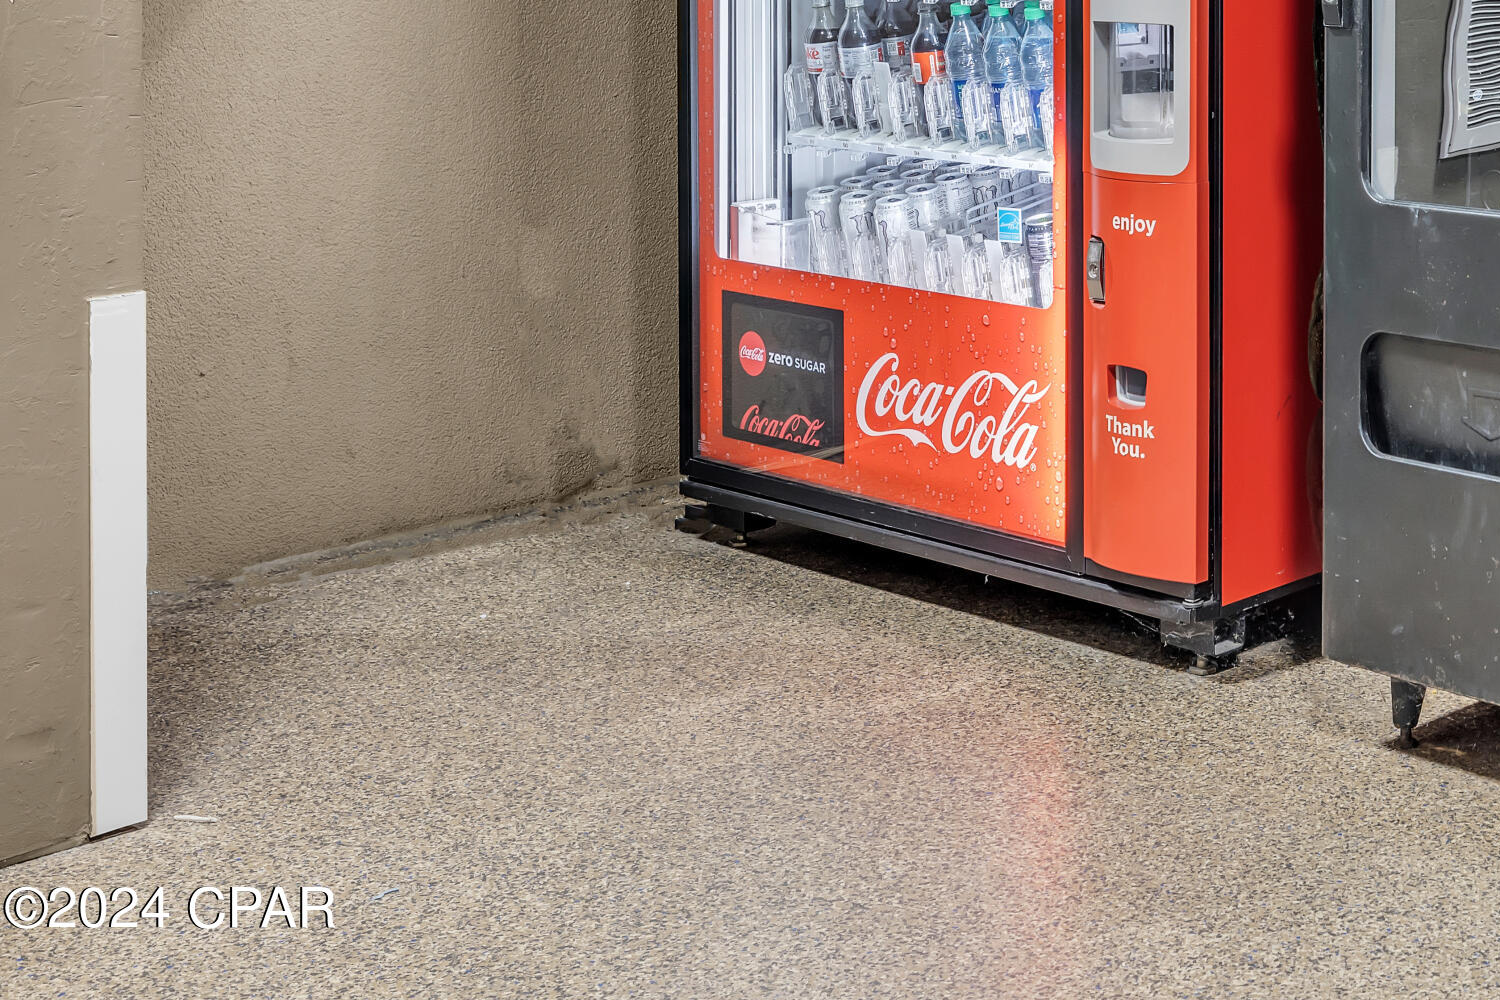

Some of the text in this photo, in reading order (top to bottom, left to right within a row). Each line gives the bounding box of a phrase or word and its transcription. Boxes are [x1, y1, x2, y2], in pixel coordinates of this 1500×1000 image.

[1112, 214, 1157, 237] enjoy
[740, 345, 826, 375] Coca-Cola zero SUGAR
[855, 353, 1052, 470] Coca-Cola
[1105, 415, 1155, 440] Thank
[1112, 437, 1146, 460] You.
